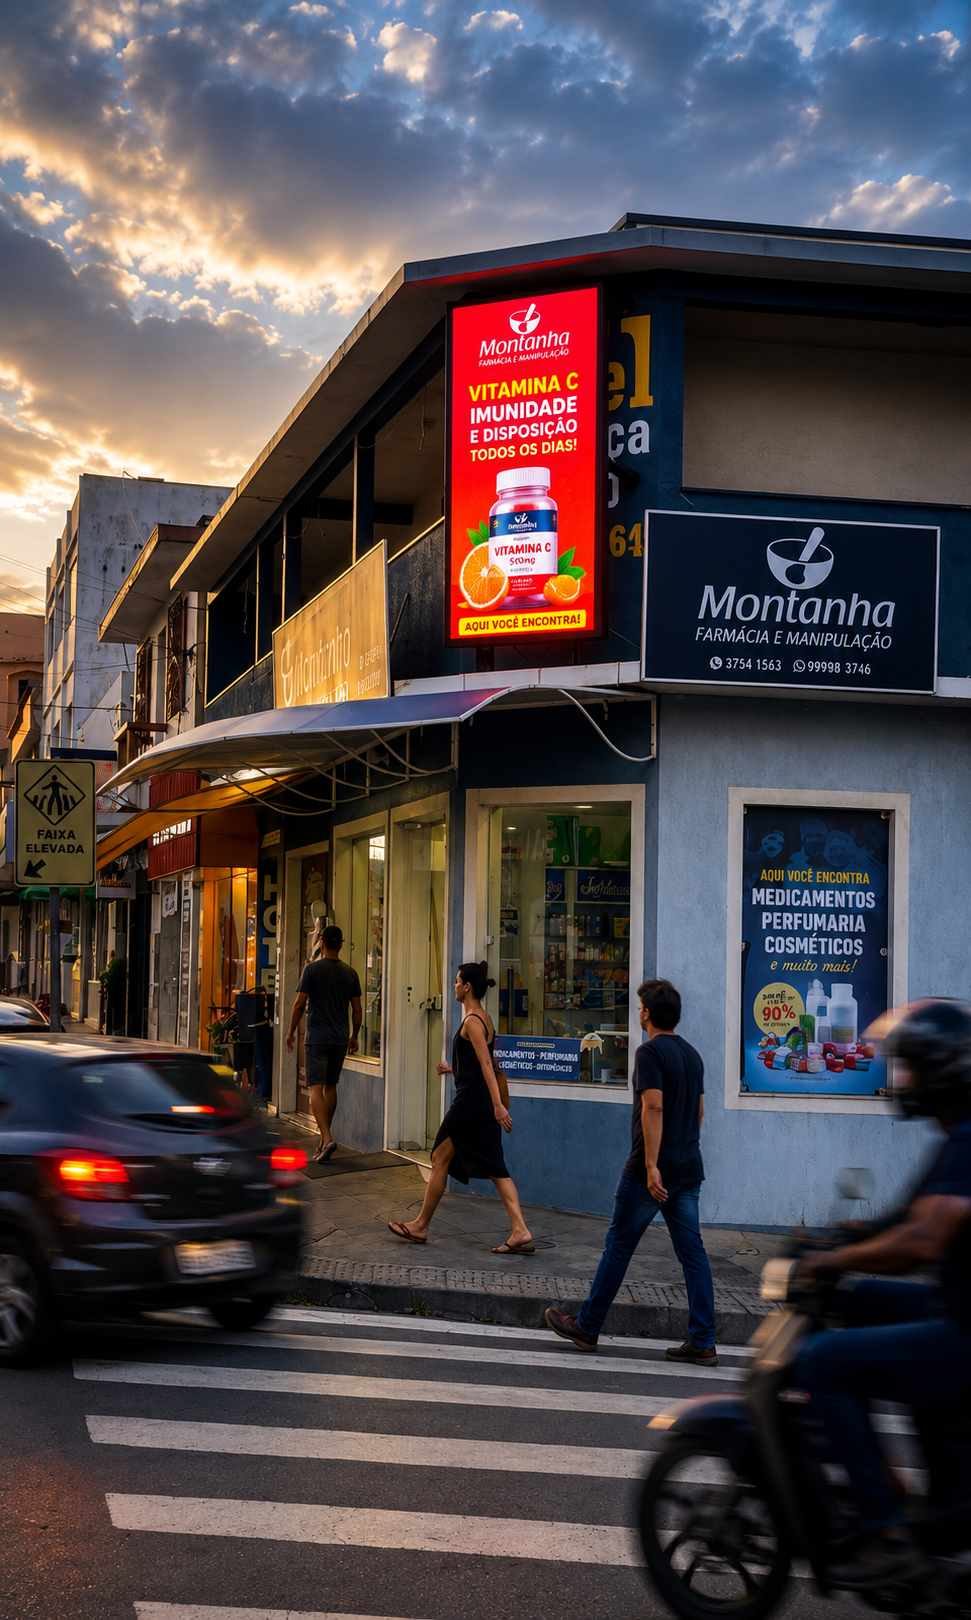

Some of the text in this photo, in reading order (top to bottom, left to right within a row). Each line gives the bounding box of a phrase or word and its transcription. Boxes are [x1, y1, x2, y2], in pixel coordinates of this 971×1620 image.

[479, 330, 570, 358] Montanha
[478, 355, 512, 367] FARMÁCIA
[518, 346, 569, 361] MANIPULAÇÃO
[468, 372, 579, 402] VITAMINA C
[470, 396, 578, 424] IMUNIDADE
[470, 430, 479, 444] E
[470, 438, 578, 462] TODOS OS DIAS!
[494, 542, 552, 556] VITAMINA C
[698, 584, 896, 628] Montanha
[464, 620, 489, 632] AQUI
[522, 614, 581, 628] ENCONTRA!
[695, 626, 892, 652] FARMÁCIA E MANIPULAÇÃO
[726, 658, 871, 675] 3754 1563 99998 3746
[37, 830, 76, 840] FAIXA
[26, 844, 84, 854] ELEVADA
[760, 869, 784, 882] AQUI
[816, 872, 870, 884] ENCONTRA
[752, 888, 876, 908] MEDICAMENTOS
[762, 912, 866, 932] PERFUMARIA
[764, 932, 864, 956] COSMÉTICOS
[770, 959, 858, 973] e muito mais!
[762, 1004, 796, 1021] 90%
